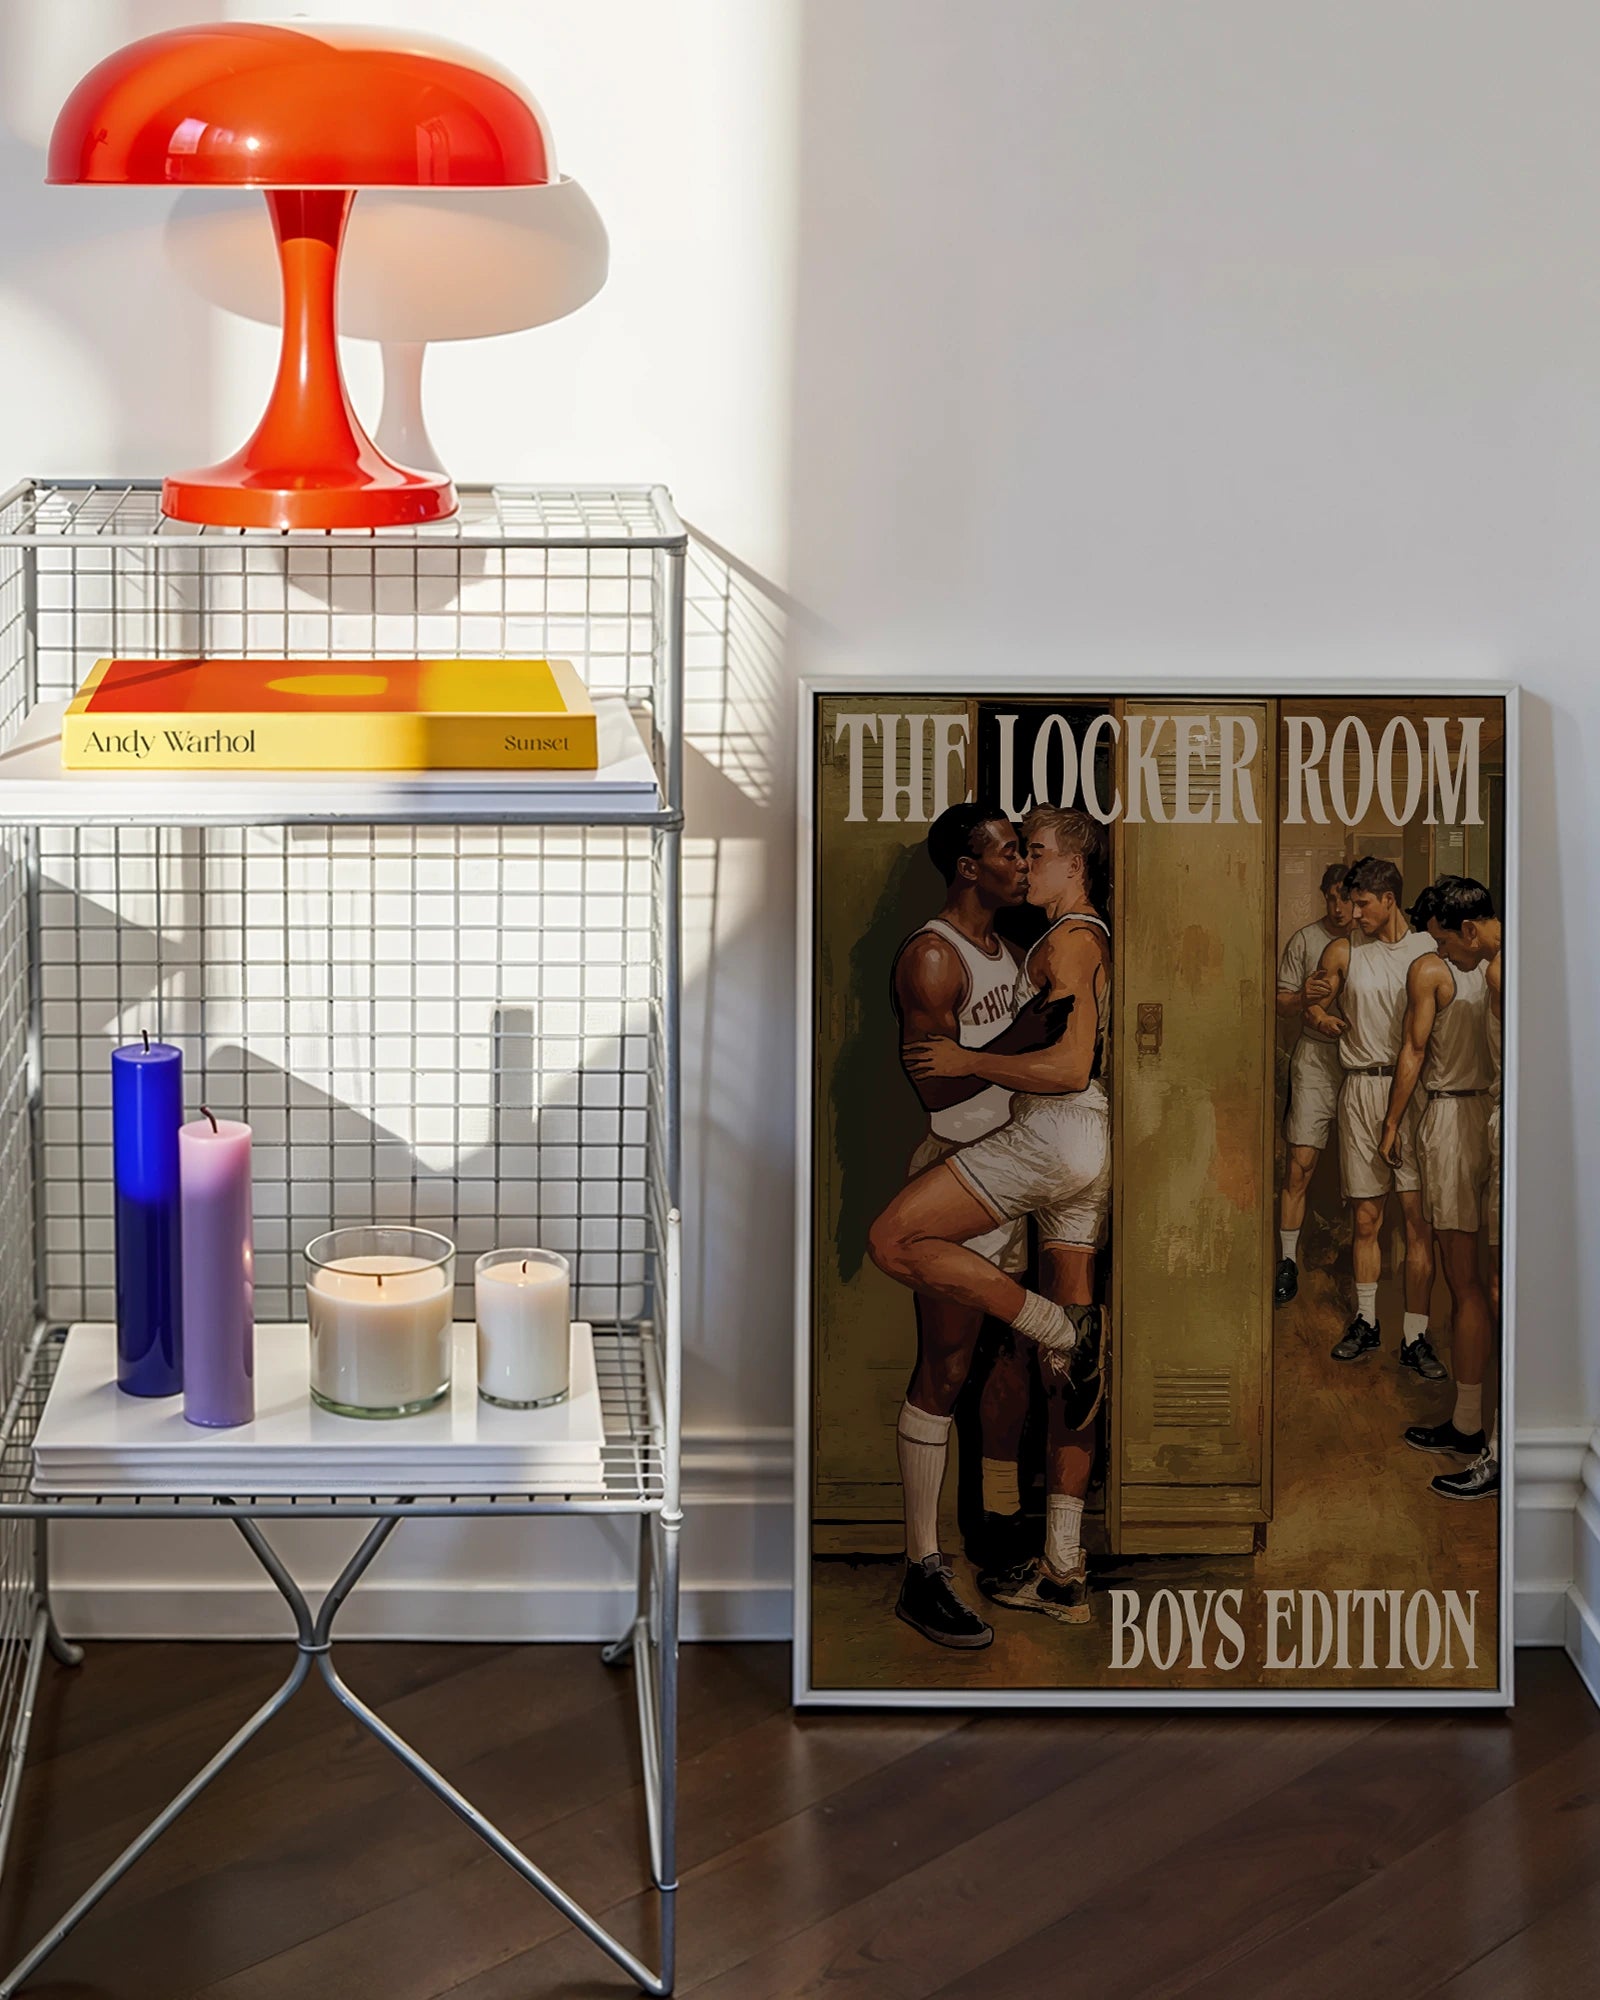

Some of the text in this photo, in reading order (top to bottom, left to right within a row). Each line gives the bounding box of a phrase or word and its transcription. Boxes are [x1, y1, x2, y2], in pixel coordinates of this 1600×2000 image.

[83, 729, 256, 759] Andy Warhol
[504, 735, 569, 751] Sunset
[834, 713, 1486, 827] THE LOCKER ROOM
[1108, 1589, 1480, 1671] BOYS EDITION
